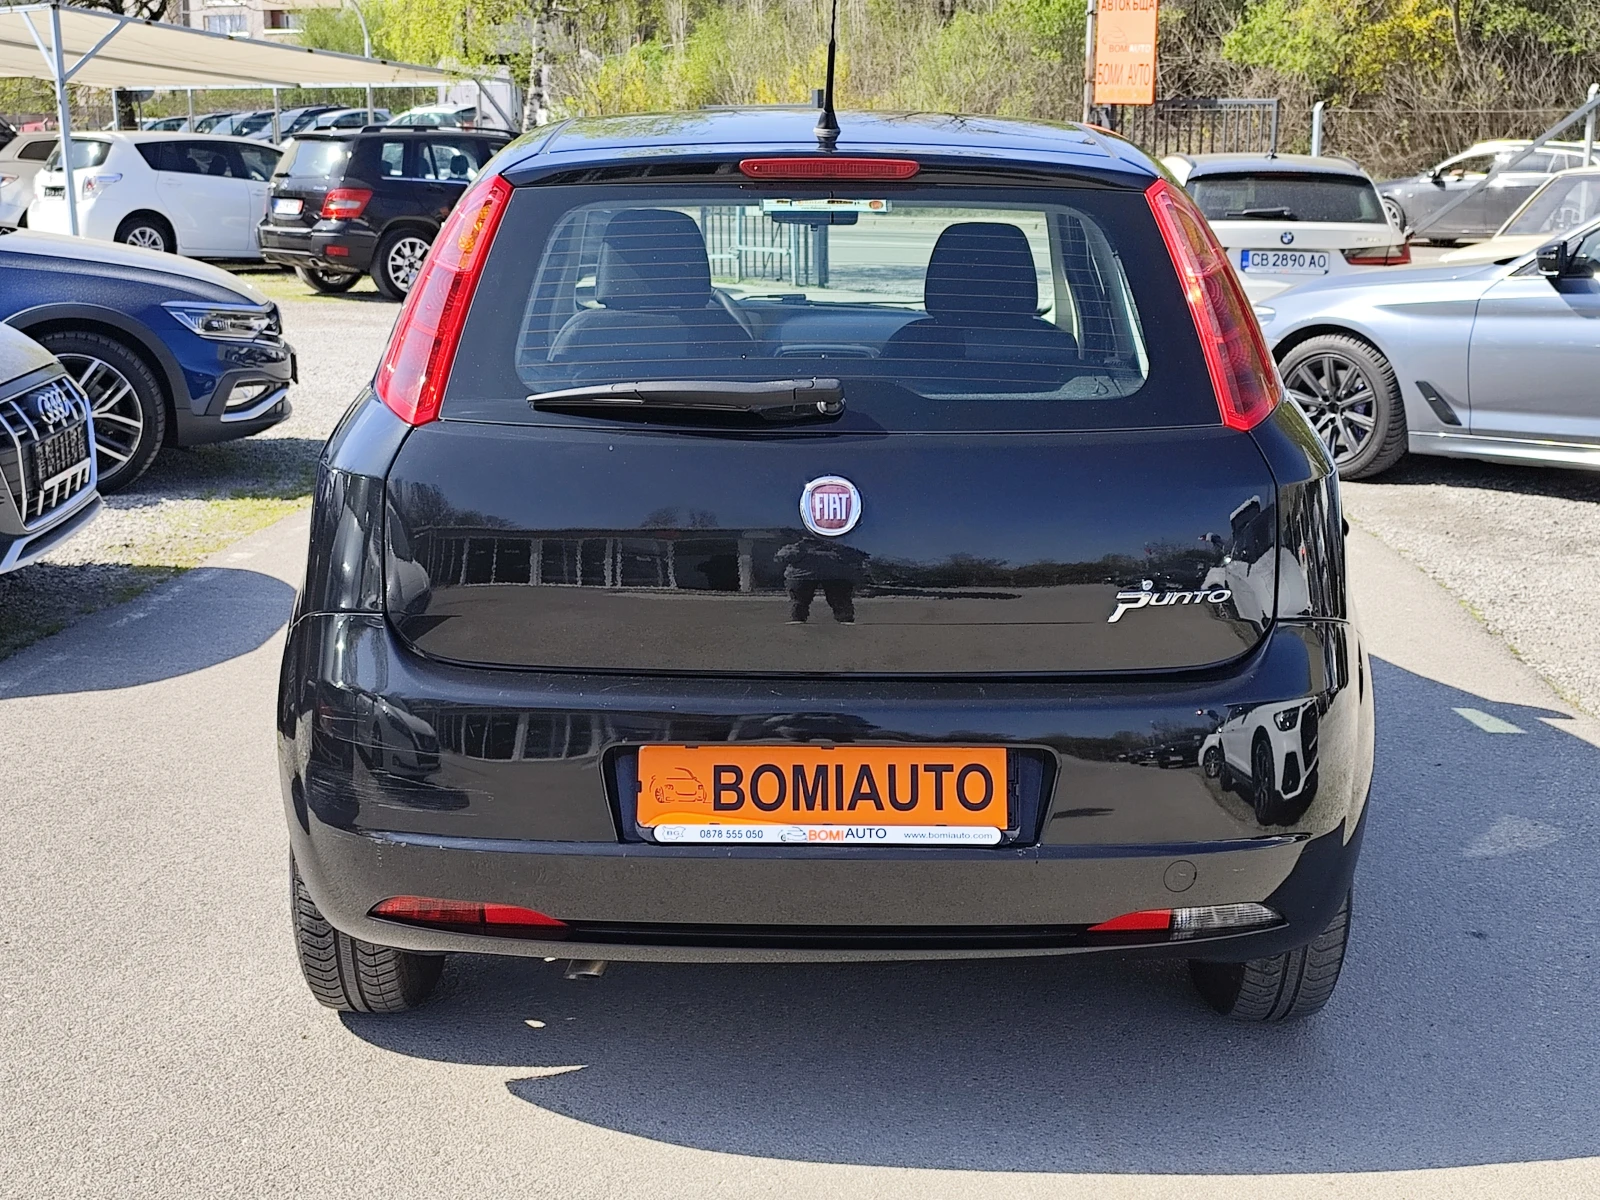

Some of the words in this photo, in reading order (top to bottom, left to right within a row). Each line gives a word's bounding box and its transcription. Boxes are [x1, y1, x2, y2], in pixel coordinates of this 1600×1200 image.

[1098, 63, 1124, 85] БОМИ
[1128, 63, 1151, 86] АУТО
[1251, 253, 1270, 267] CB
[1272, 253, 1306, 268] 2890
[814, 492, 850, 521] FIAT
[712, 763, 995, 812] BOMIAUTO
[699, 829, 723, 839] 0878
[725, 829, 743, 839] 555
[745, 829, 764, 839] 050
[903, 831, 993, 841] www.bomiauto.com
